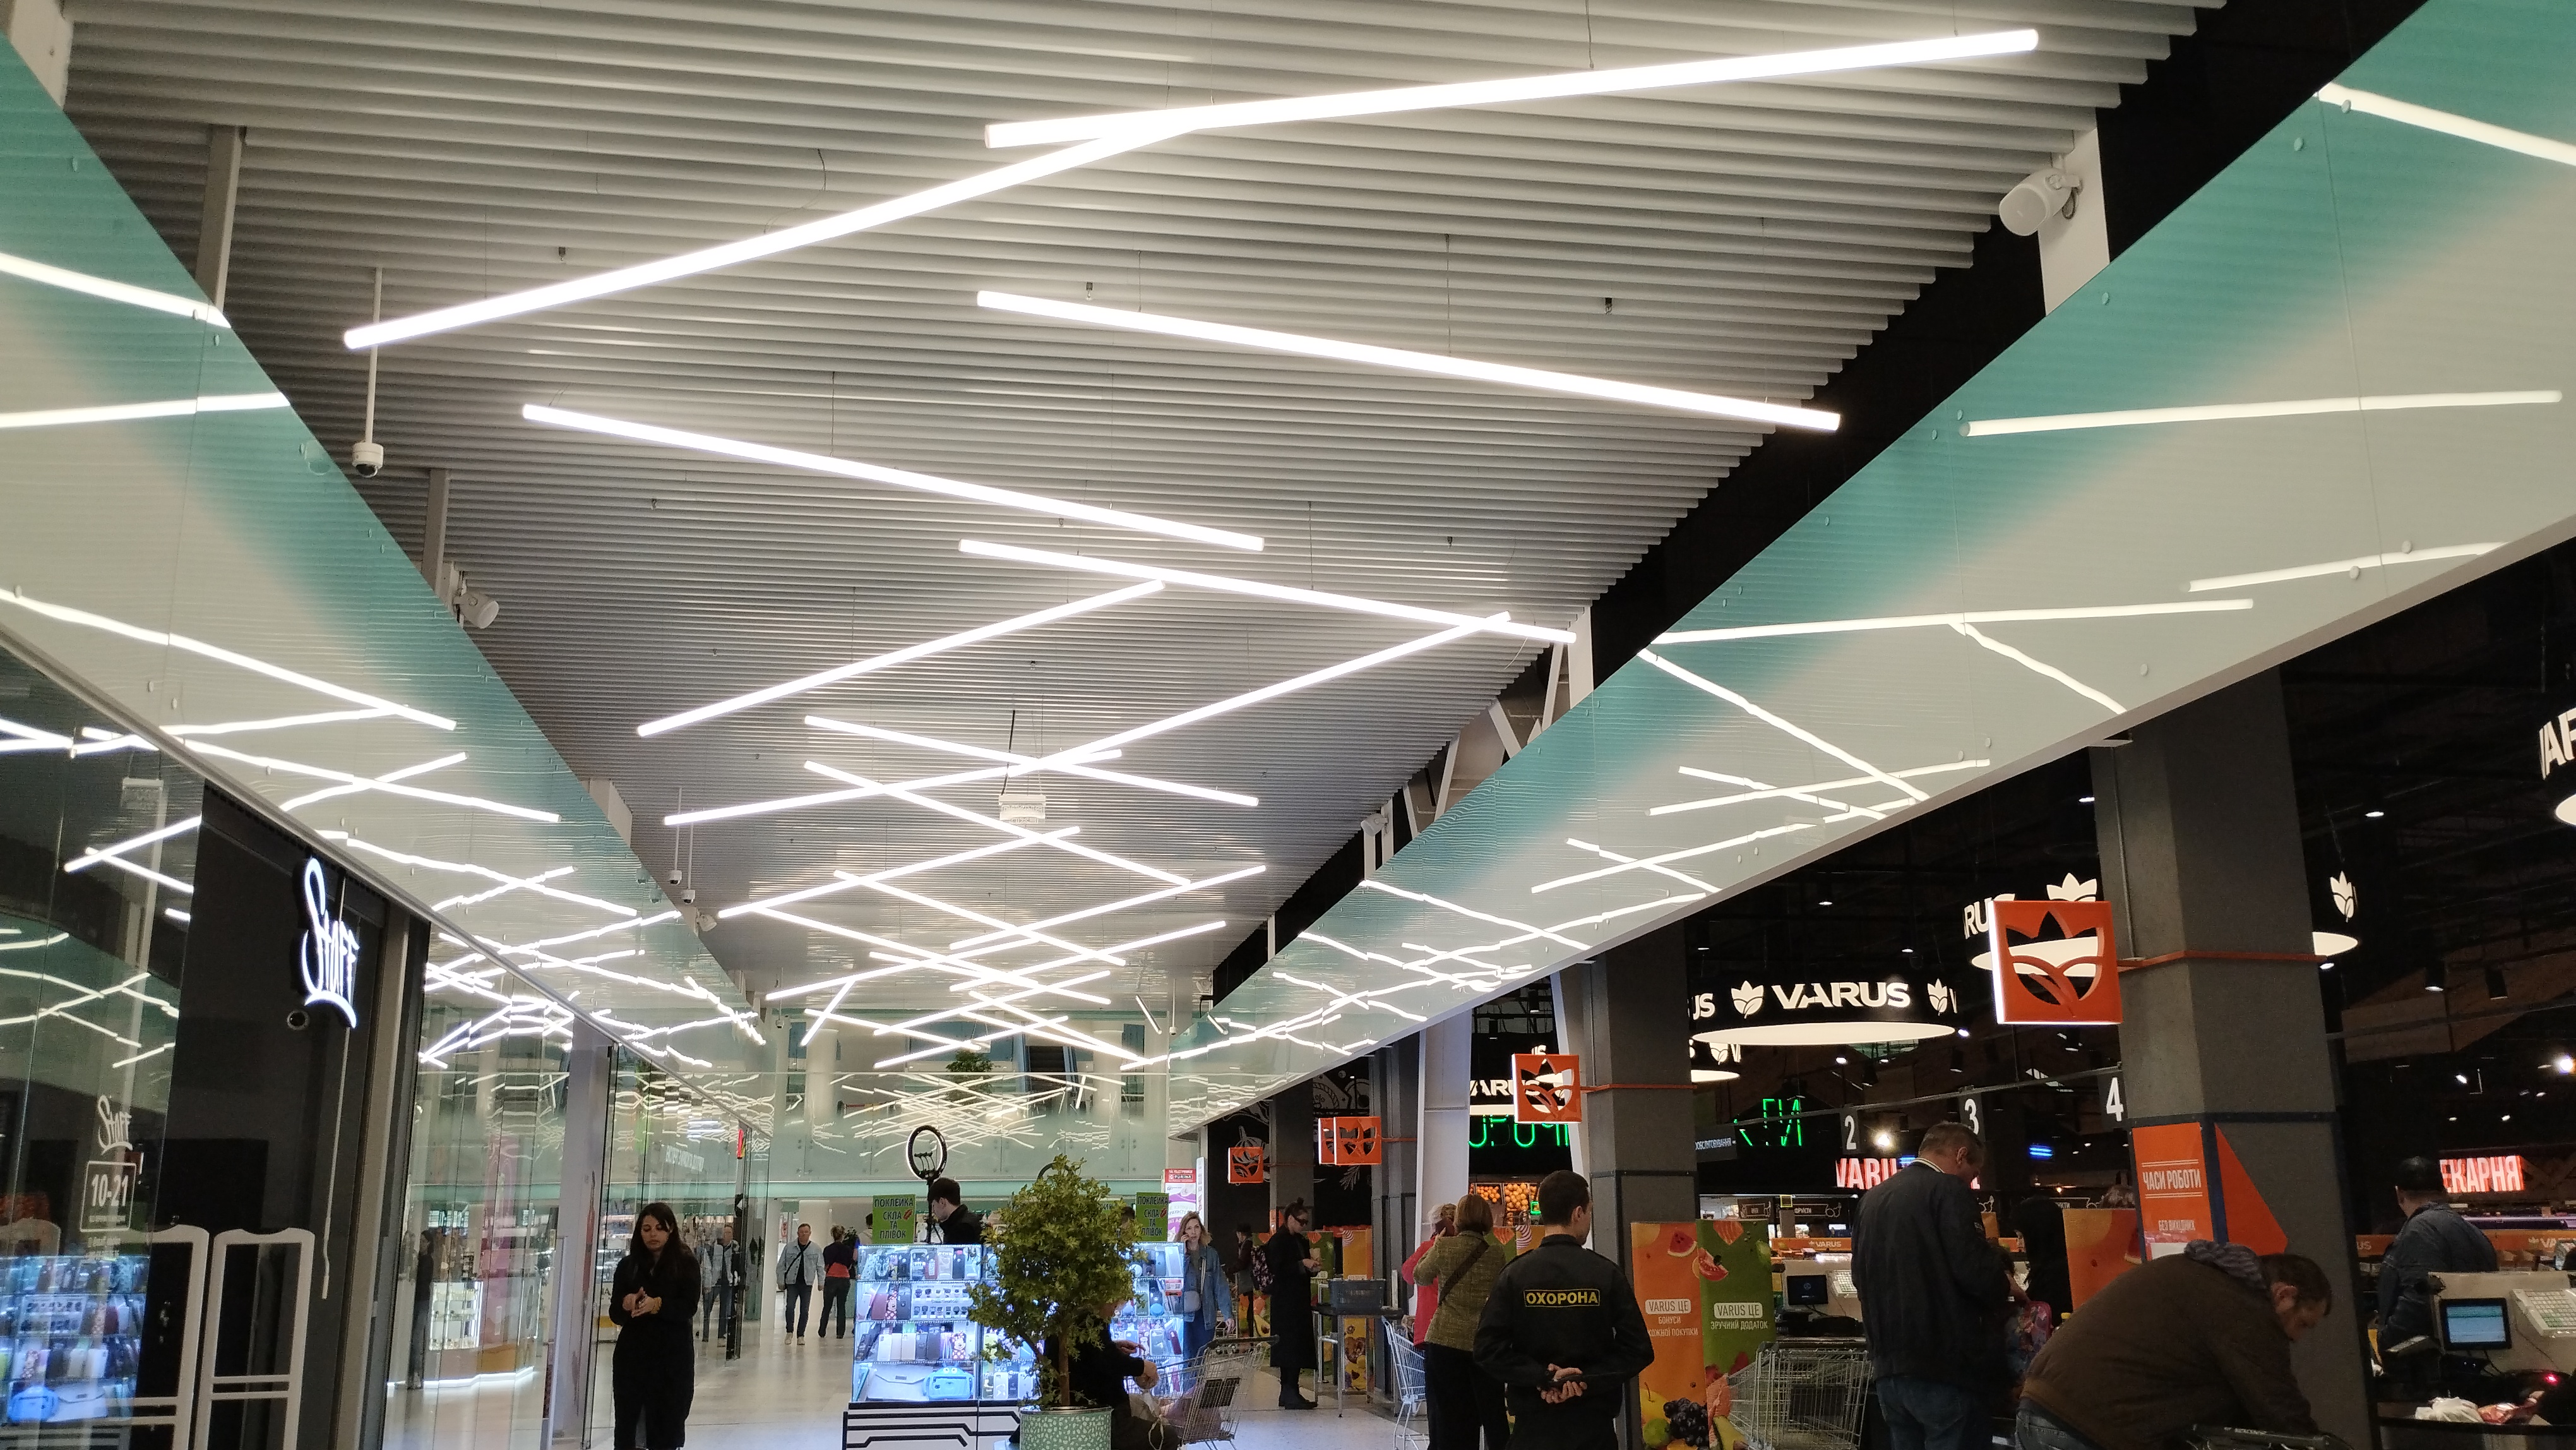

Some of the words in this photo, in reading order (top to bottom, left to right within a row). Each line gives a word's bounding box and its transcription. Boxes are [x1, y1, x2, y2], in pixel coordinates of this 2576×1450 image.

[1771, 981, 1911, 1010] VARUS
[2106, 1077, 2124, 1122] 4
[1964, 1098, 1979, 1135] 3
[1844, 1115, 1857, 1150] 2
[2142, 1170, 2166, 1190] ЧАСИ
[2166, 1168, 2202, 1189] РОБОТИ
[92, 1173, 129, 1207] 10-21
[874, 1196, 914, 1207] ПОКЛЕЙКА
[1138, 1195, 1169, 1205] ПОКЛЕЙКА
[883, 1211, 902, 1220] СКЛА
[1144, 1209, 1159, 1218] СКЛА
[890, 1221, 897, 1230] ТА
[1149, 1218, 1156, 1226] ТА
[880, 1230, 906, 1238] ПЛІВОК
[1525, 1291, 1599, 1305] ОХОРОНА
[1649, 1300, 1676, 1312] VARUS
[1678, 1300, 1689, 1314] ЦЕ
[1717, 1304, 1746, 1317] VARUS
[1748, 1304, 1760, 1317] ЦЕ
[1658, 1315, 1681, 1325] БОНУСИ
[1710, 1319, 1739, 1330] ЗРУЧНИЙ
[1740, 1320, 1768, 1331] ДОДАТОК
[1672, 1327, 1698, 1336] ПОКУПКИ
